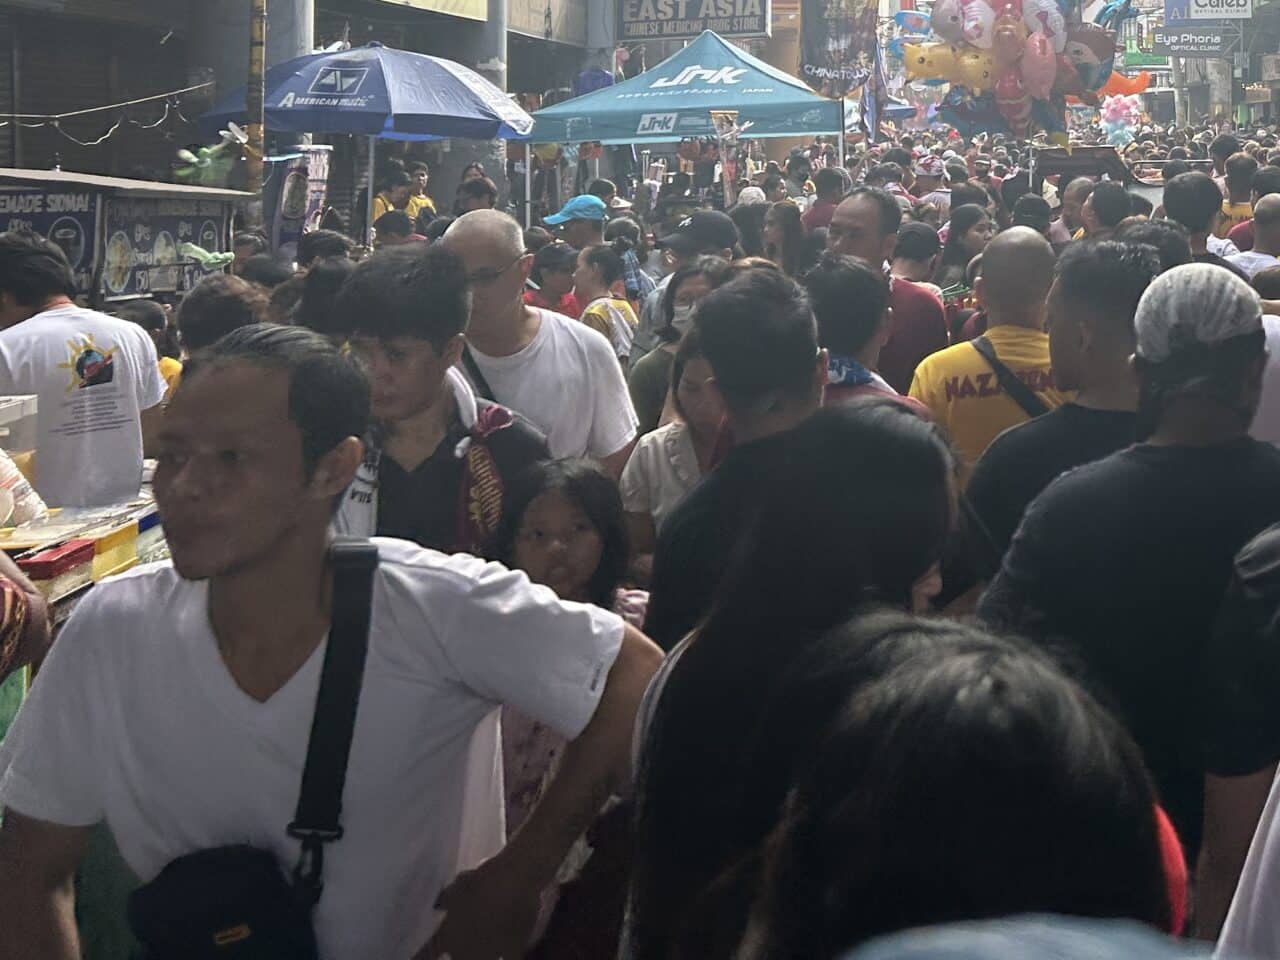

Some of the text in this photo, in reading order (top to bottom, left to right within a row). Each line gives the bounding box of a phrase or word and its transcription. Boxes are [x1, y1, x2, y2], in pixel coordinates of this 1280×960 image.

[731, 15, 761, 30] STORE
[1155, 32, 1221, 45] Eye Phoria
[803, 63, 873, 81] CHINATOWN
[277, 92, 339, 108] AMERICAN
